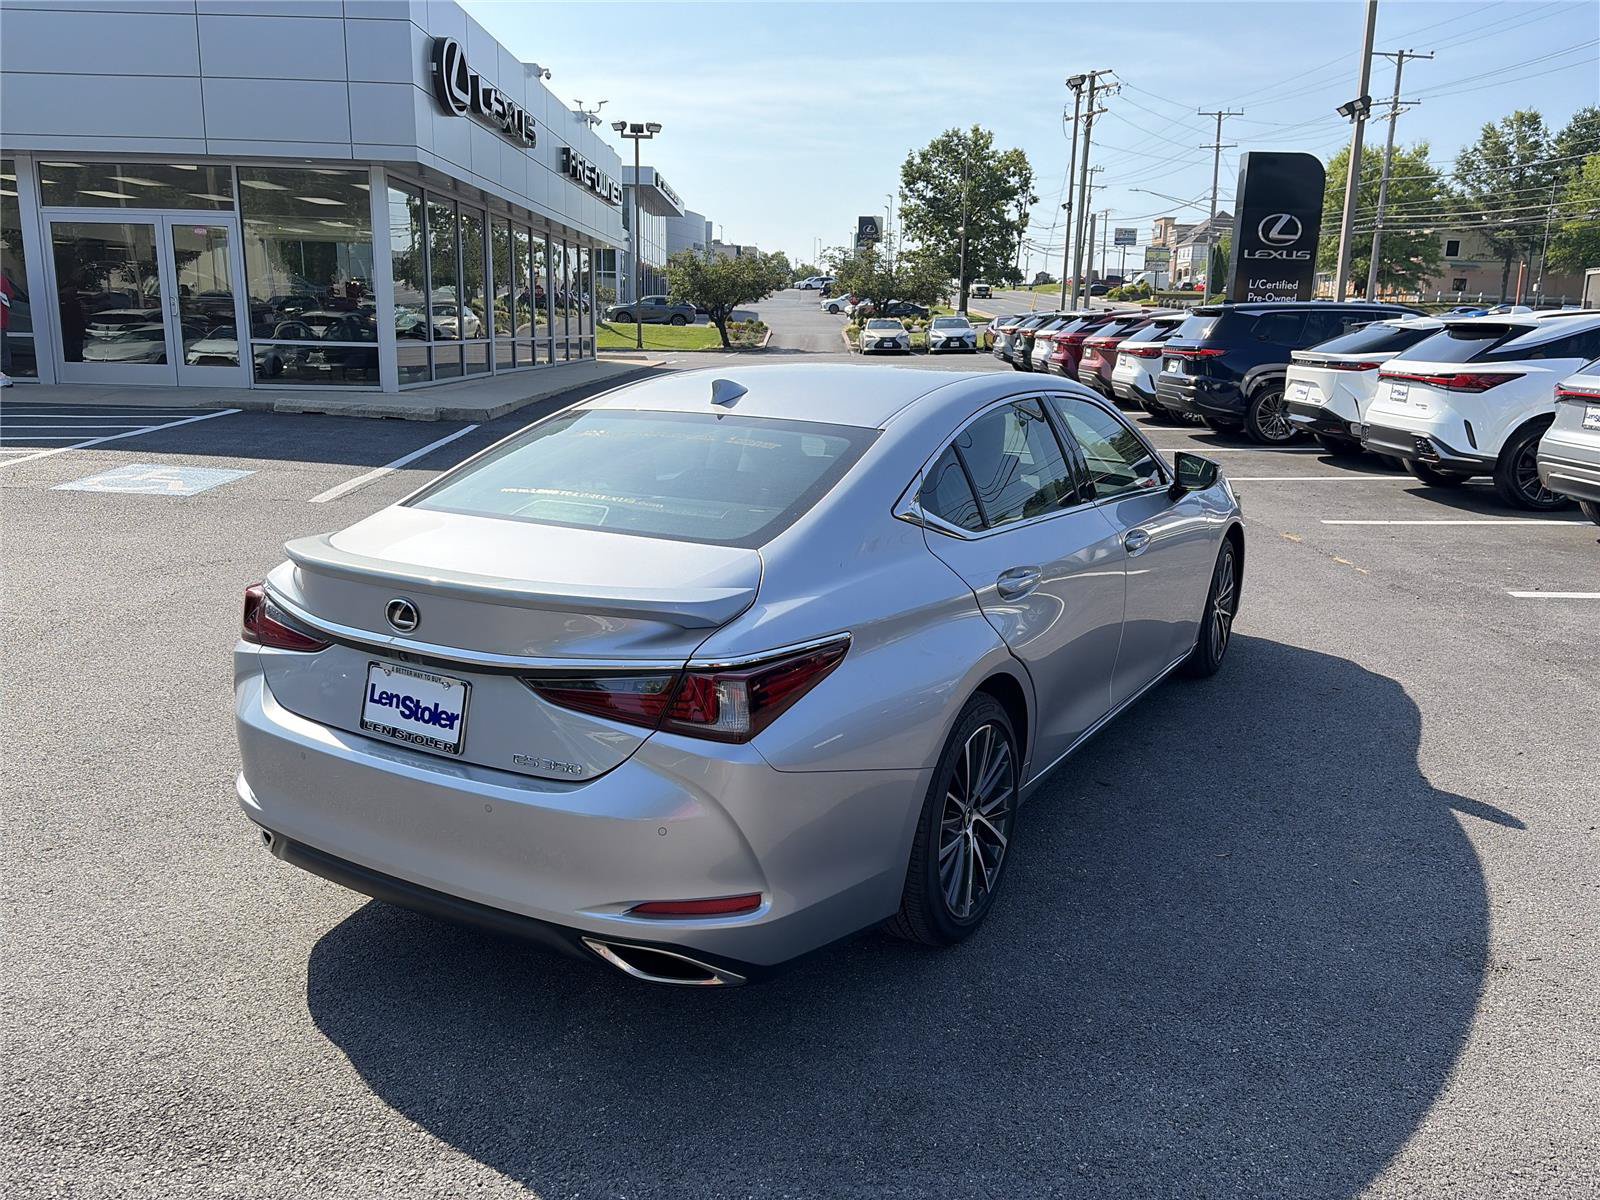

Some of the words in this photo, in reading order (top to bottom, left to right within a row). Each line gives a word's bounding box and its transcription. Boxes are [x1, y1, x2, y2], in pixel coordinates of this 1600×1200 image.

[470, 74, 537, 149] LEXUS
[1244, 249, 1311, 260] LEXUS
[1248, 279, 1299, 290] L/Certified
[1247, 293, 1298, 303] Pre-Owned
[395, 667, 413, 676] BETTER
[413, 671, 423, 679] WAY
[424, 673, 431, 681] TO
[432, 675, 442, 684] BUY
[364, 721, 392, 736] LEN
[394, 730, 454, 753] STOLER
[542, 758, 583, 775] 350
